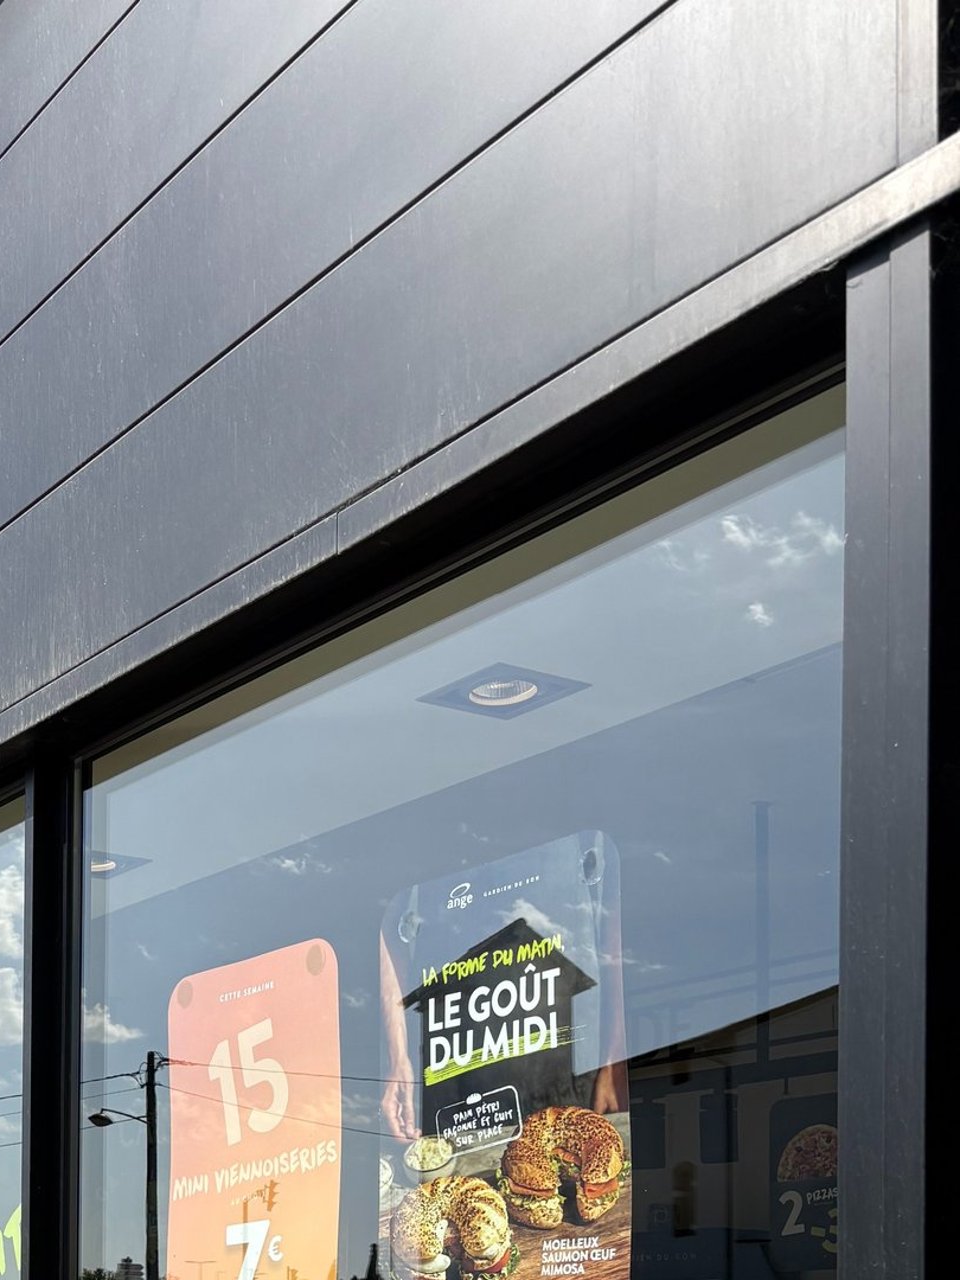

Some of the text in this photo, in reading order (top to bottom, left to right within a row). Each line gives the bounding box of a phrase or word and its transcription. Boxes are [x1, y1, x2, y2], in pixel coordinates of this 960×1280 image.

[447, 893, 473, 909] ange
[422, 967, 438, 987] LA
[442, 951, 488, 984] FORME
[493, 948, 513, 969] DU
[220, 981, 274, 1003] CETTE SEMAINE
[428, 963, 561, 1032] LE GOÛT
[429, 1011, 558, 1072] DU MIDI
[208, 1017, 289, 1147] 15
[453, 1108, 473, 1124] PAIN
[481, 1116, 490, 1126] ET
[456, 1124, 503, 1147] SUR PLACE
[173, 1163, 209, 1200] MINI
[215, 1139, 338, 1195] VIENNOISERIES
[806, 1187, 838, 1204] PIZZAS
[778, 1190, 806, 1236] 2
[542, 1236, 599, 1250] MOELLEUX
[542, 1248, 616, 1262] SAUMON ŒUF
[541, 1263, 585, 1276] MIMOSA
